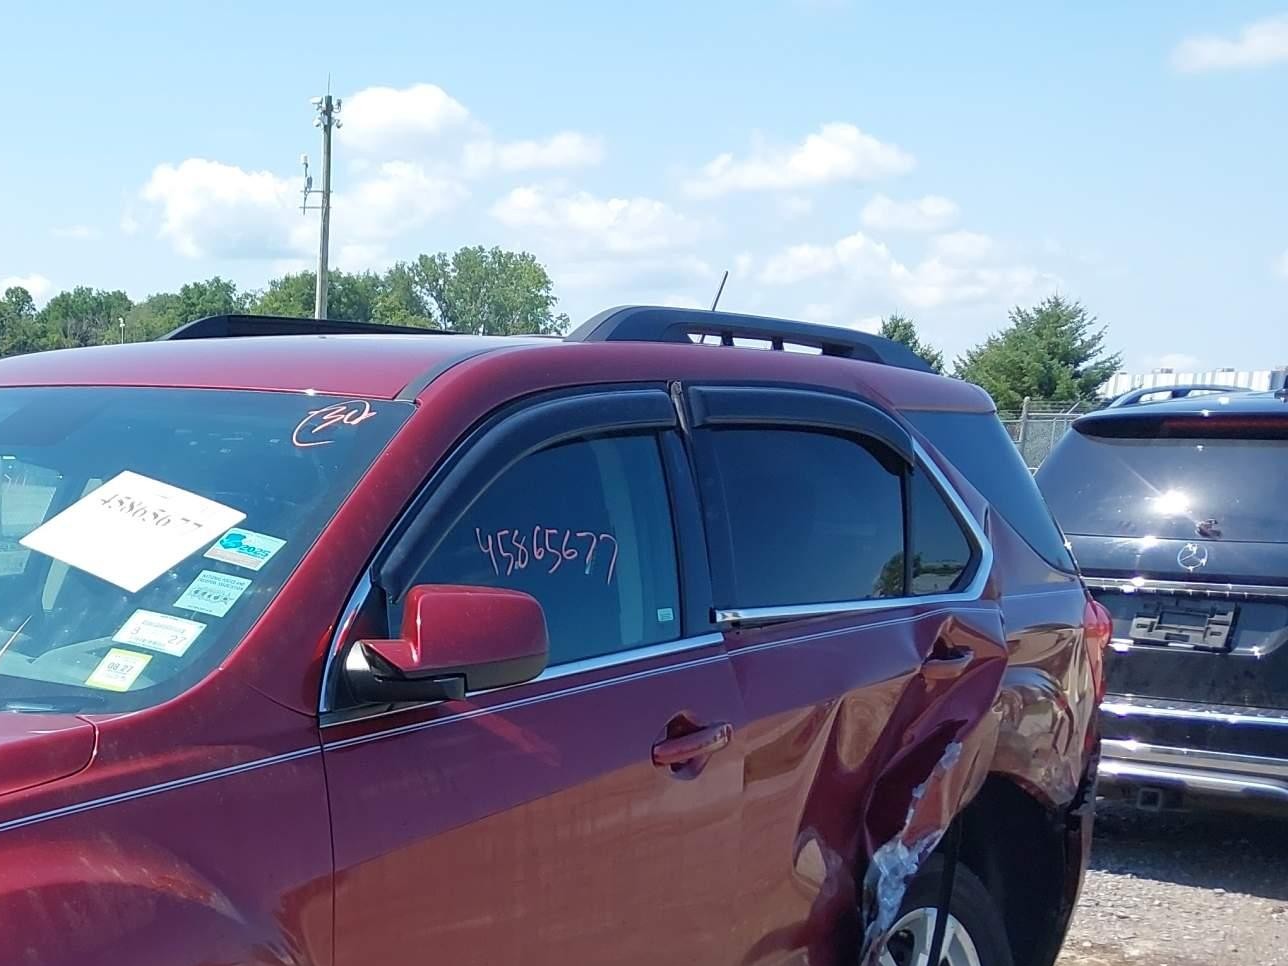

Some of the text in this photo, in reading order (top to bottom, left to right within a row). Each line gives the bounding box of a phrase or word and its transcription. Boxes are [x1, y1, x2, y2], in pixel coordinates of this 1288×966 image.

[239, 544, 271, 558] 2025
[475, 525, 619, 585] 45865677
[167, 634, 187, 646] 27
